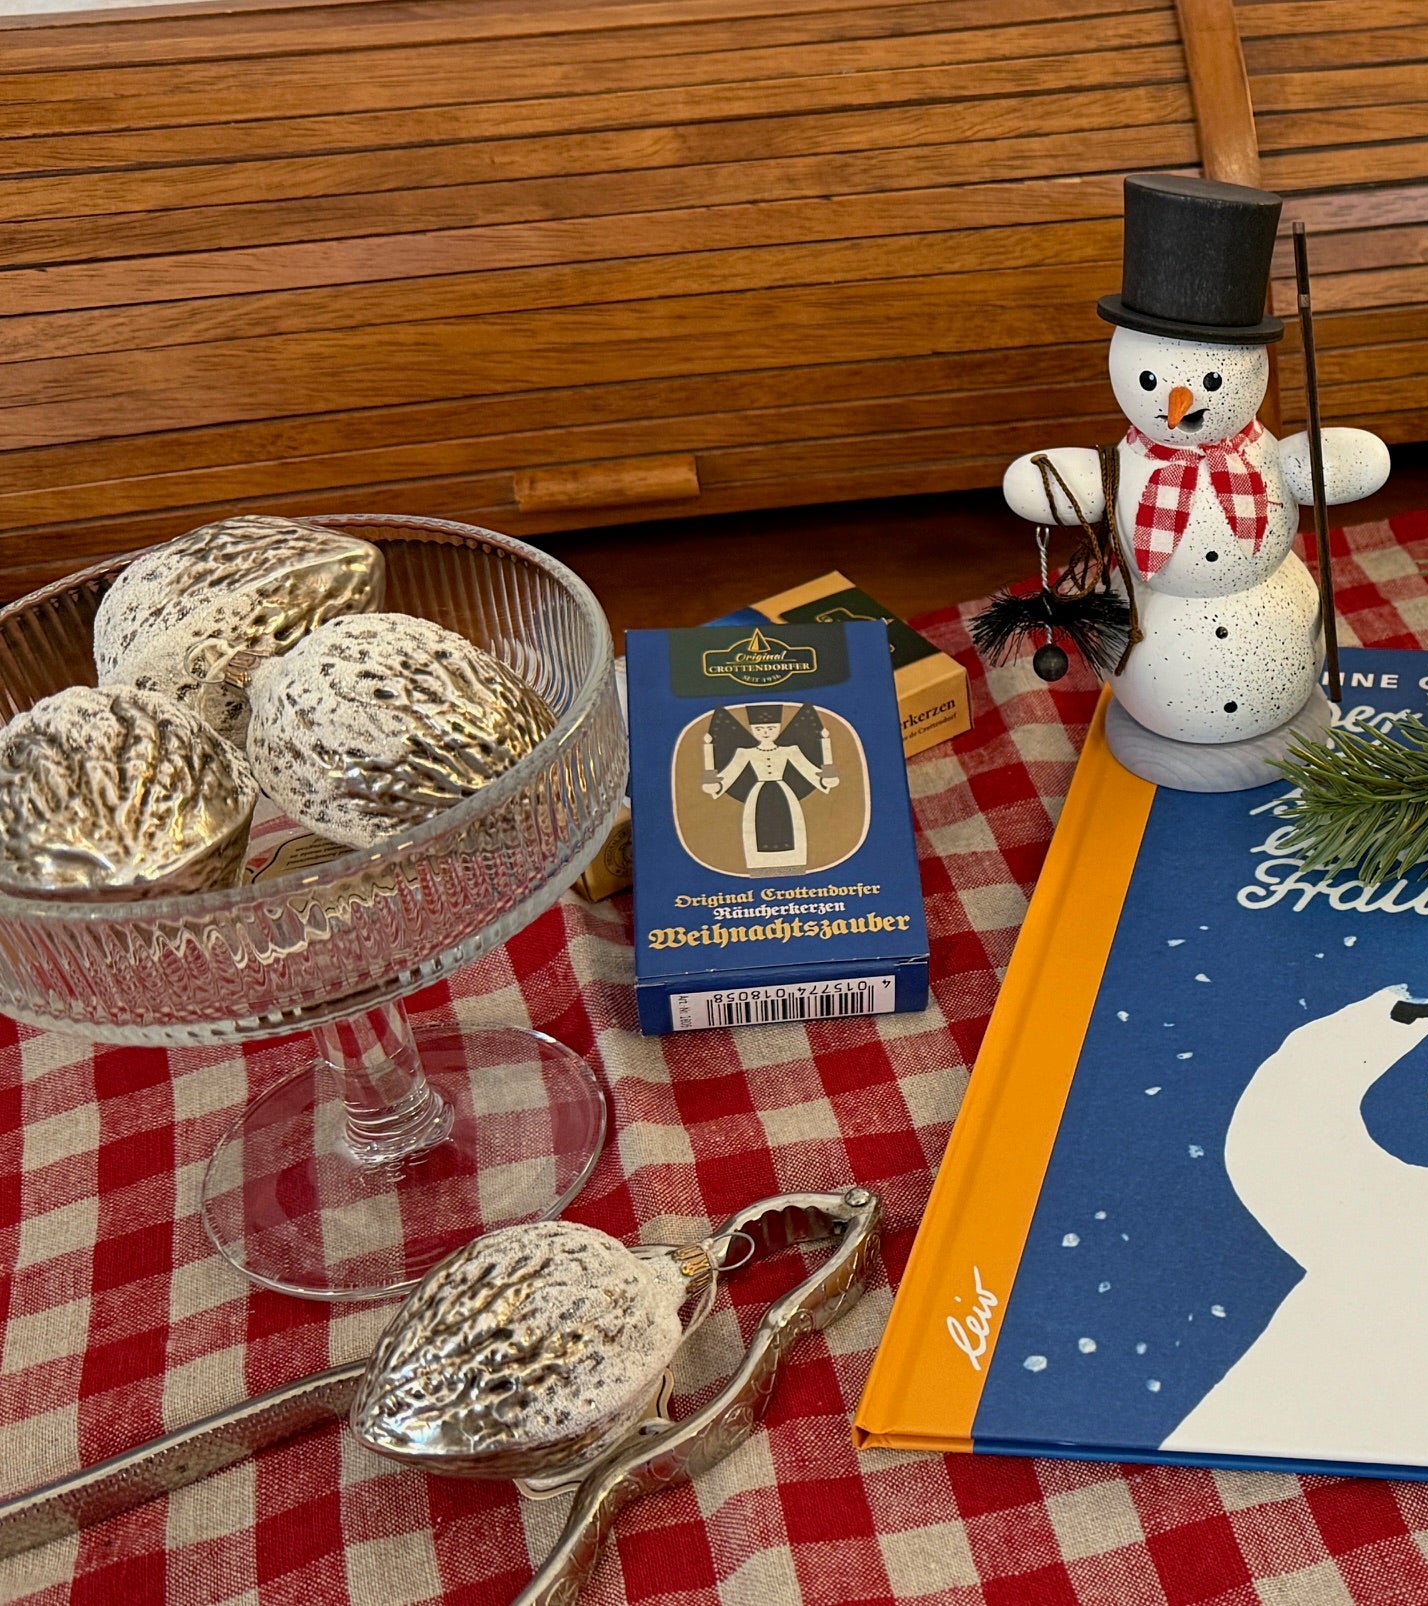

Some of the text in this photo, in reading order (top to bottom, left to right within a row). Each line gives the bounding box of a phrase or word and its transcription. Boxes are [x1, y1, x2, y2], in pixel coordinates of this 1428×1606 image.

[709, 662, 811, 673] CROTTENDORFER
[735, 650, 787, 663] Original
[902, 699, 956, 729] rkerzen
[674, 883, 881, 908] Original Crottendorfer
[713, 902, 845, 920] Räucherkerzen
[648, 911, 911, 950] Weihnachtszauber
[713, 980, 891, 1003] 4 015774 018058
